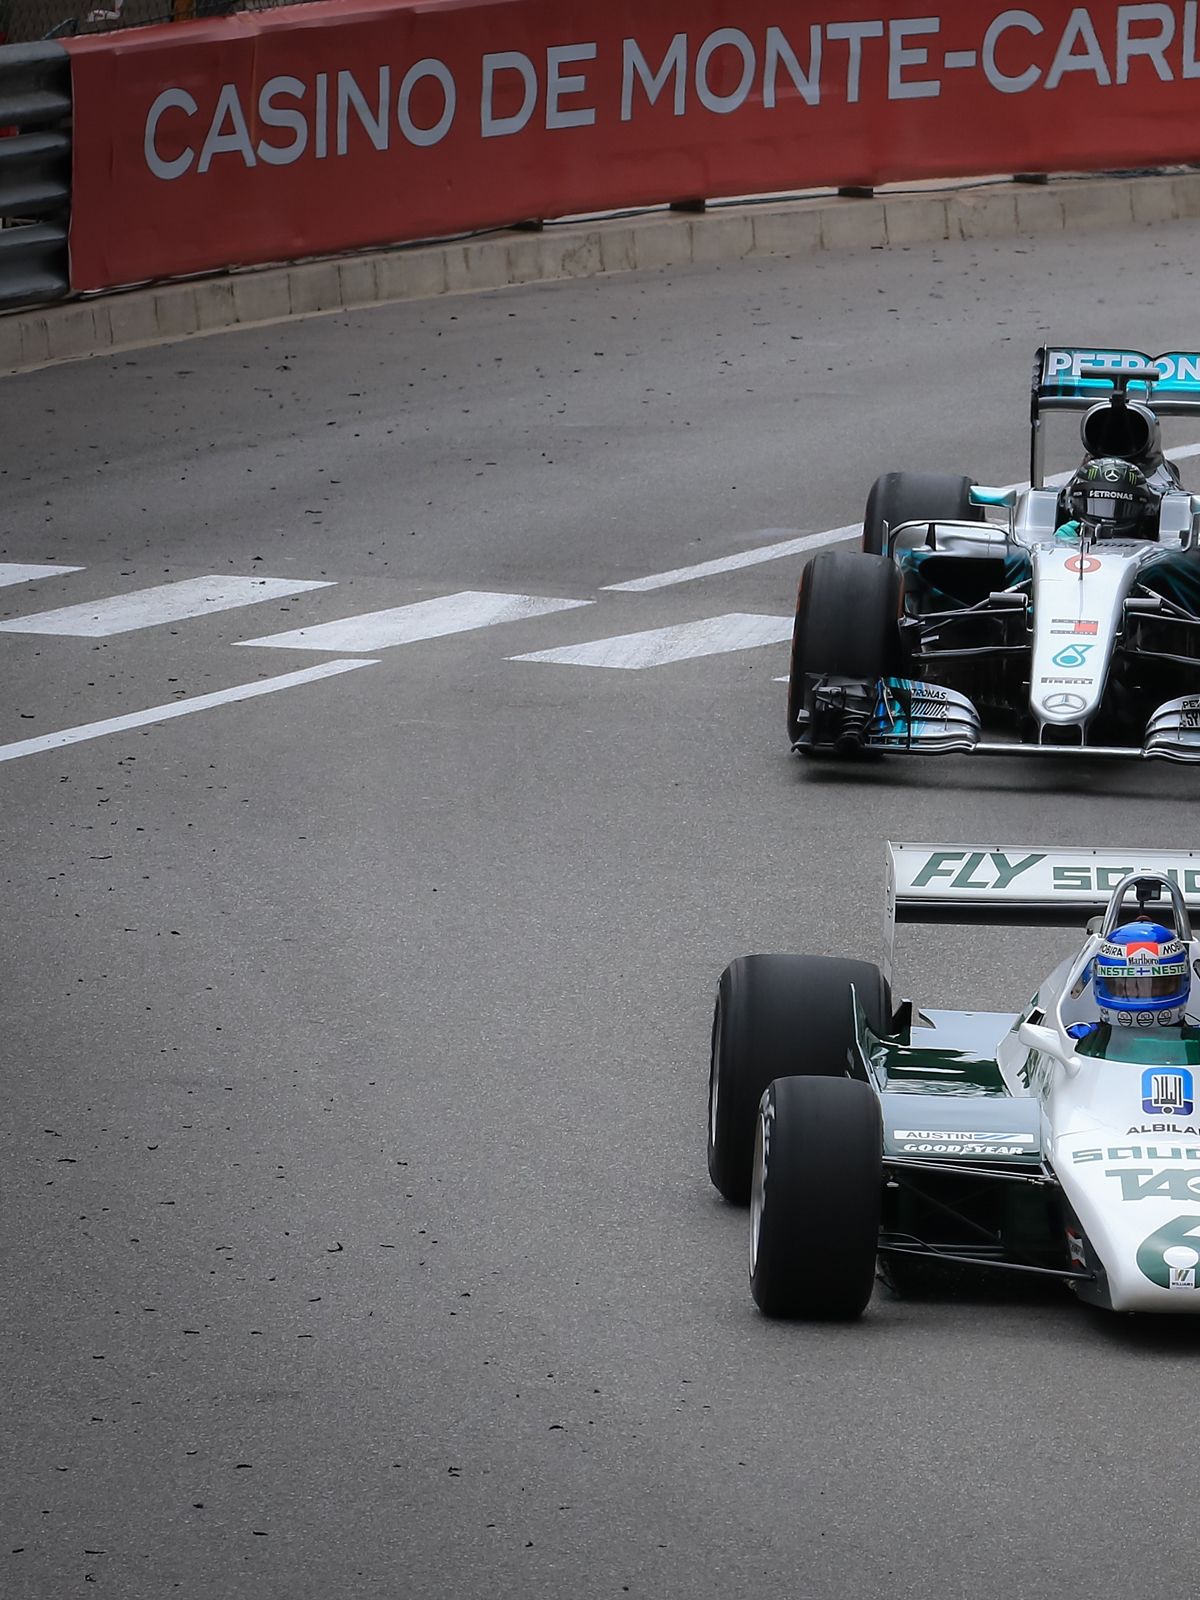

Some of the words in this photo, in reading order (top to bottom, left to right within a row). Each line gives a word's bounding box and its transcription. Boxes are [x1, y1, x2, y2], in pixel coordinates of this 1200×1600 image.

[144, 58, 457, 180] CASINO
[481, 42, 597, 138] DE
[1089, 490, 1133, 501] PETRONAS
[910, 852, 1047, 889] FLY
[1128, 953, 1159, 965] Marlboro
[1100, 966, 1135, 976] NESTE
[1151, 964, 1185, 976] NESTE
[905, 1131, 973, 1140] AUSTIN
[903, 1143, 1024, 1155] GOODYEAR
